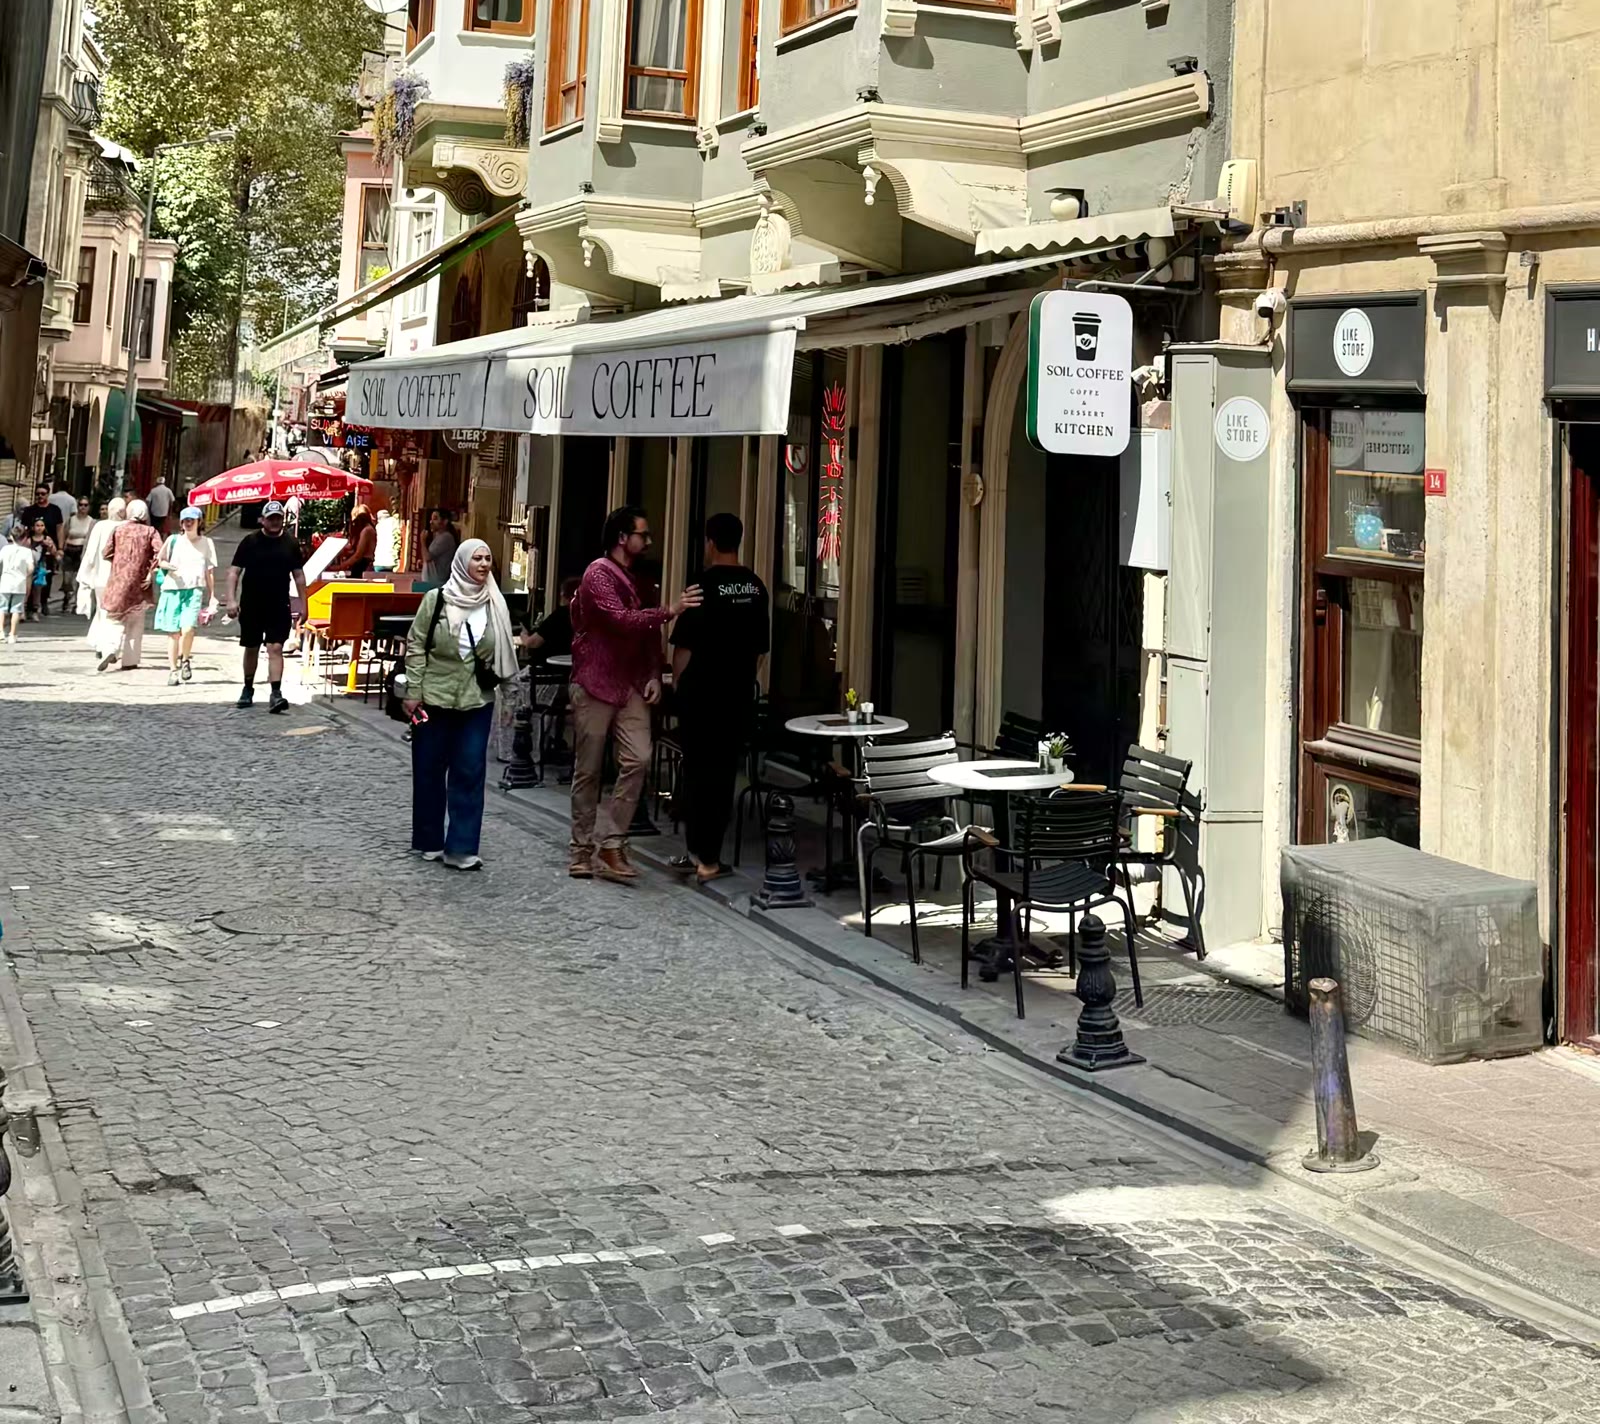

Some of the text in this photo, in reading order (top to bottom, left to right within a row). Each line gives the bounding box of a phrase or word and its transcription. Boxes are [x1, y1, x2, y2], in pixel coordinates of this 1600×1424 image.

[1342, 328, 1358, 342] LIKE
[1342, 343, 1365, 357] STORE
[1046, 364, 1124, 381] SOIL COFFEE
[524, 353, 717, 420] SOIL COFFEE
[361, 373, 461, 418] SOIL COFFEE
[1063, 409, 1105, 418] DESSERT
[1226, 414, 1248, 427] LIKE
[1054, 423, 1114, 437] KITCHEN
[1226, 429, 1258, 443] STORE
[322, 433, 369, 447] VIAGE
[457, 442, 480, 450] COFFEE
[285, 482, 318, 494] ALGIDA
[1430, 474, 1441, 489] 14
[225, 487, 260, 500] ALGIDA
